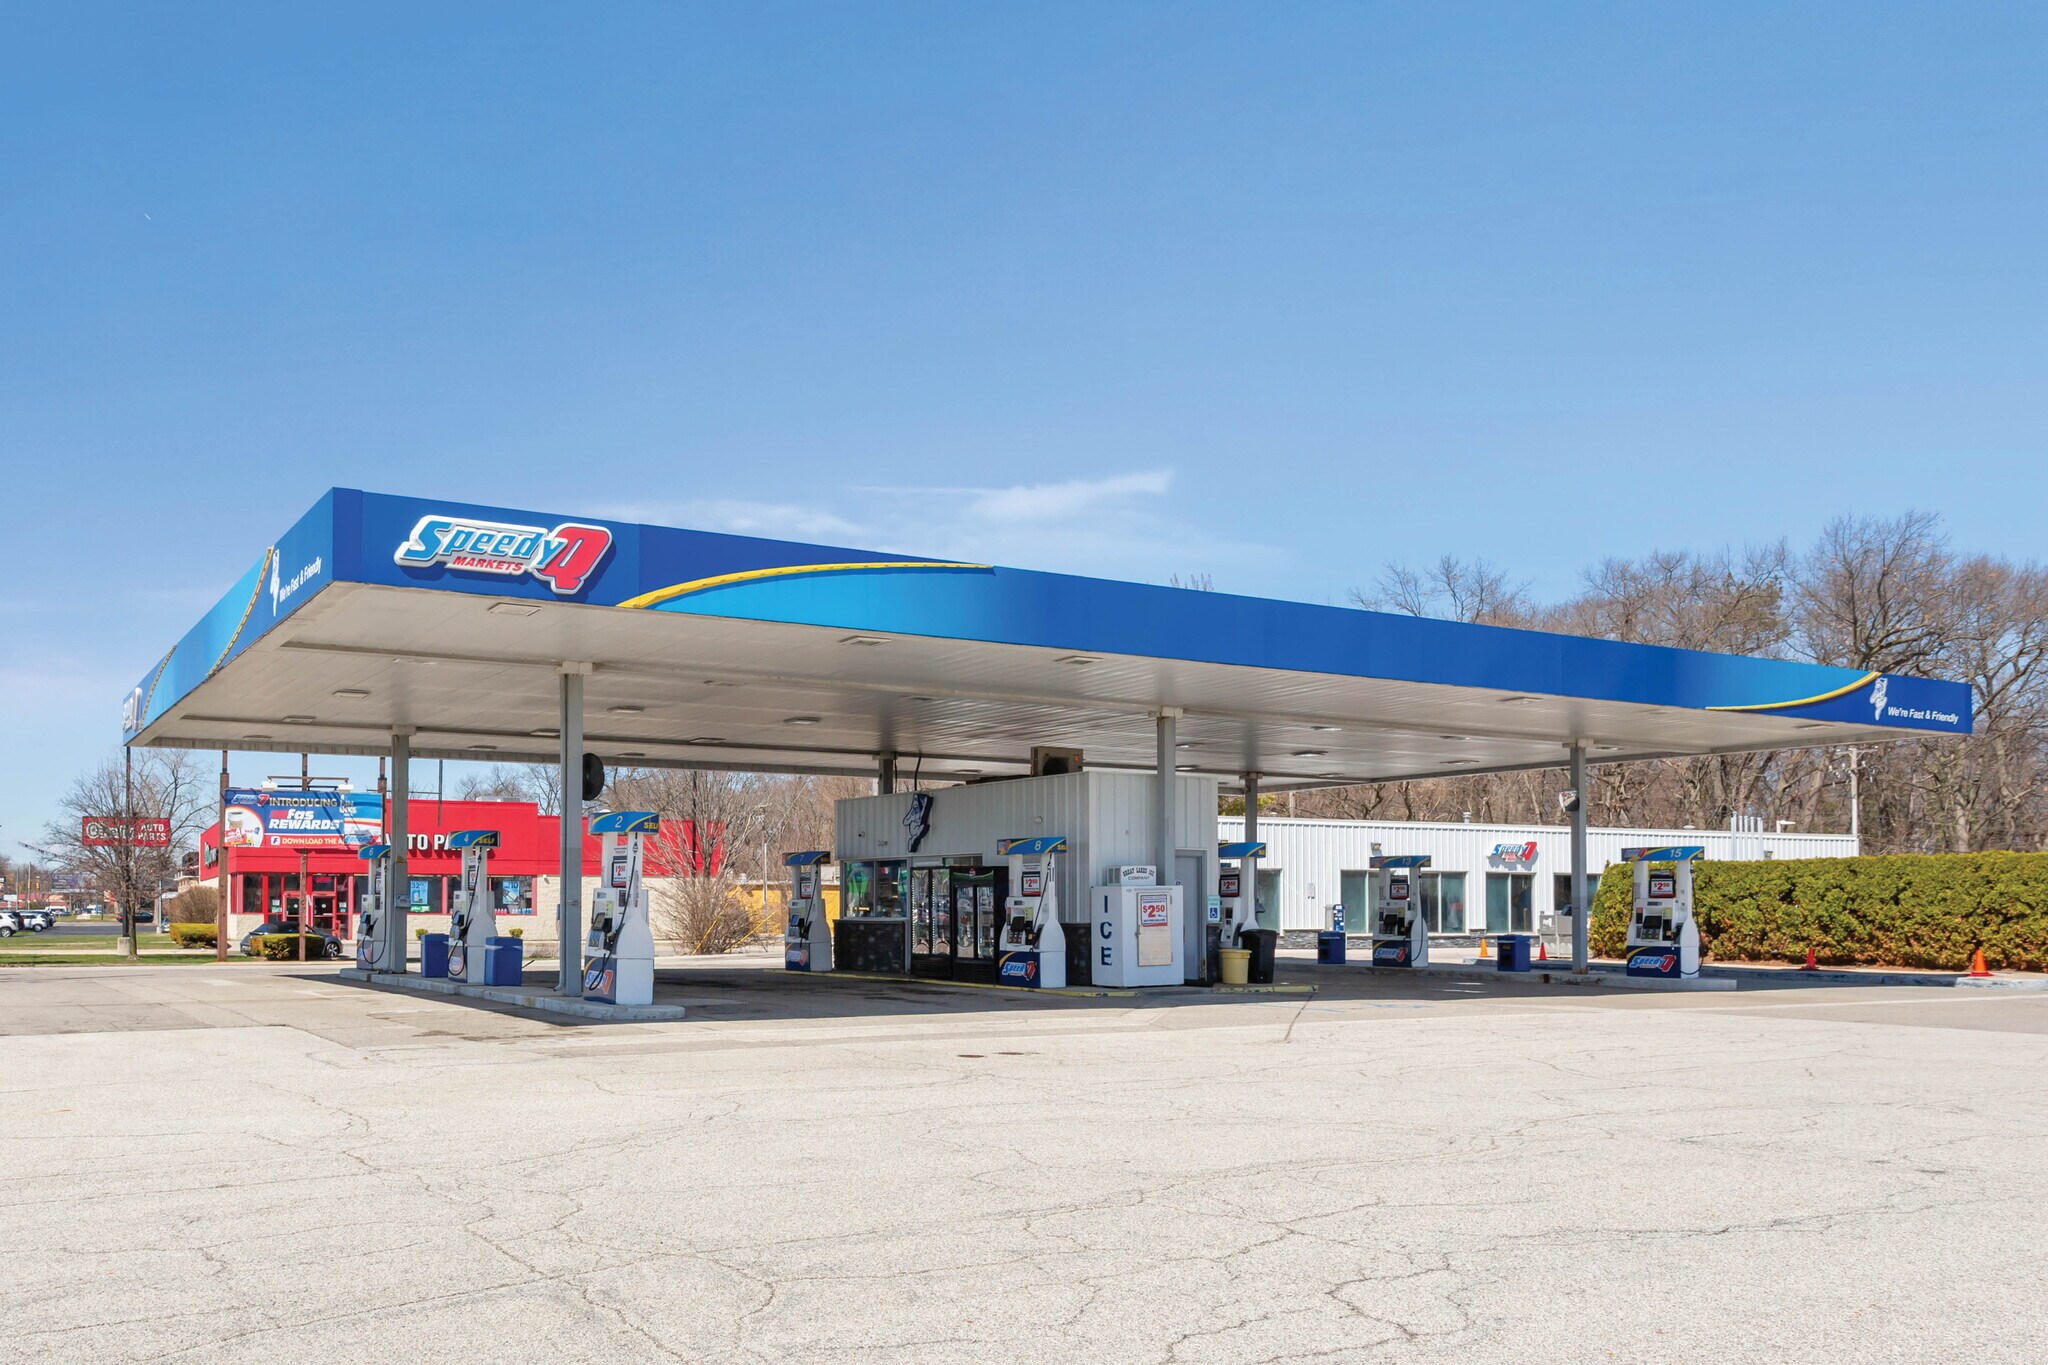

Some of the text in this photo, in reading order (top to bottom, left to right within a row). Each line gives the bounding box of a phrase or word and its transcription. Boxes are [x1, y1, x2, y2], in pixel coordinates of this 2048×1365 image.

[452, 555, 524, 573] MARKETS
[1887, 706, 1959, 724] We're Fast & Friendly
[269, 798, 338, 807] INTRODUCING
[268, 819, 340, 830] REWARDS
[614, 815, 623, 829] 2
[141, 823, 164, 831] AUTO
[464, 834, 469, 843] 4
[1035, 841, 1042, 851] 8
[369, 848, 374, 856] 6
[1670, 849, 1683, 858] 15
[1402, 857, 1412, 865] 13
